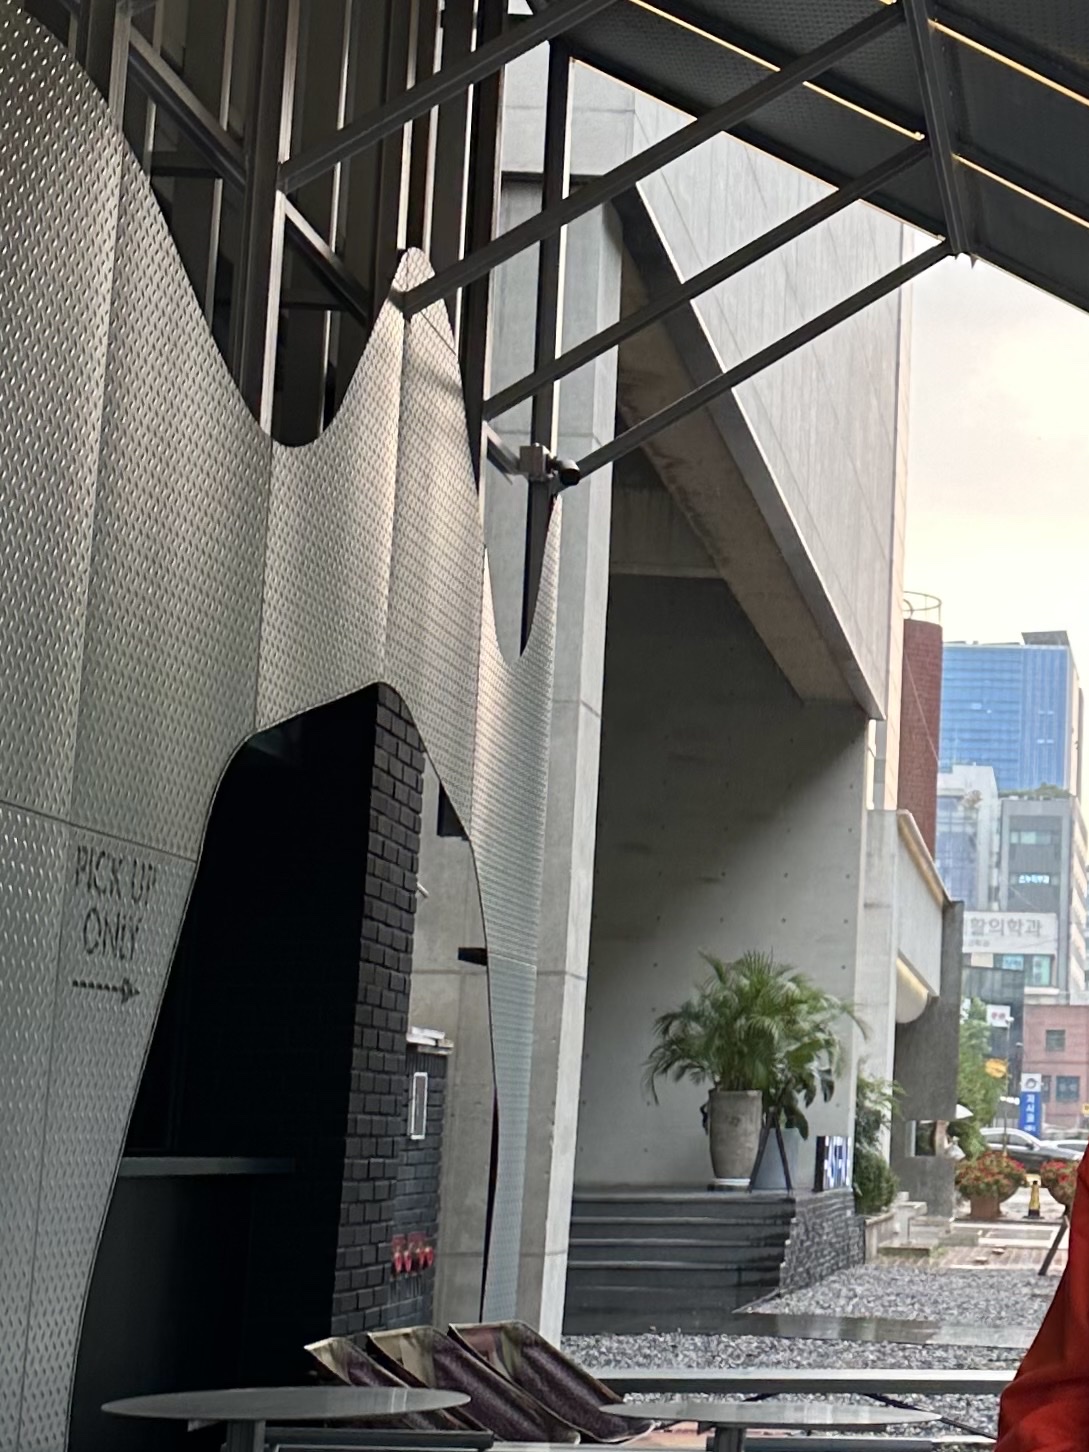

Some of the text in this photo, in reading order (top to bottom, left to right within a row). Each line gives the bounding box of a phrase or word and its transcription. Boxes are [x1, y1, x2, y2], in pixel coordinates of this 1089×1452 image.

[75, 846, 157, 906] PICK UP
[83, 907, 143, 960] ONLY
[965, 917, 1042, 938] 활의학과
